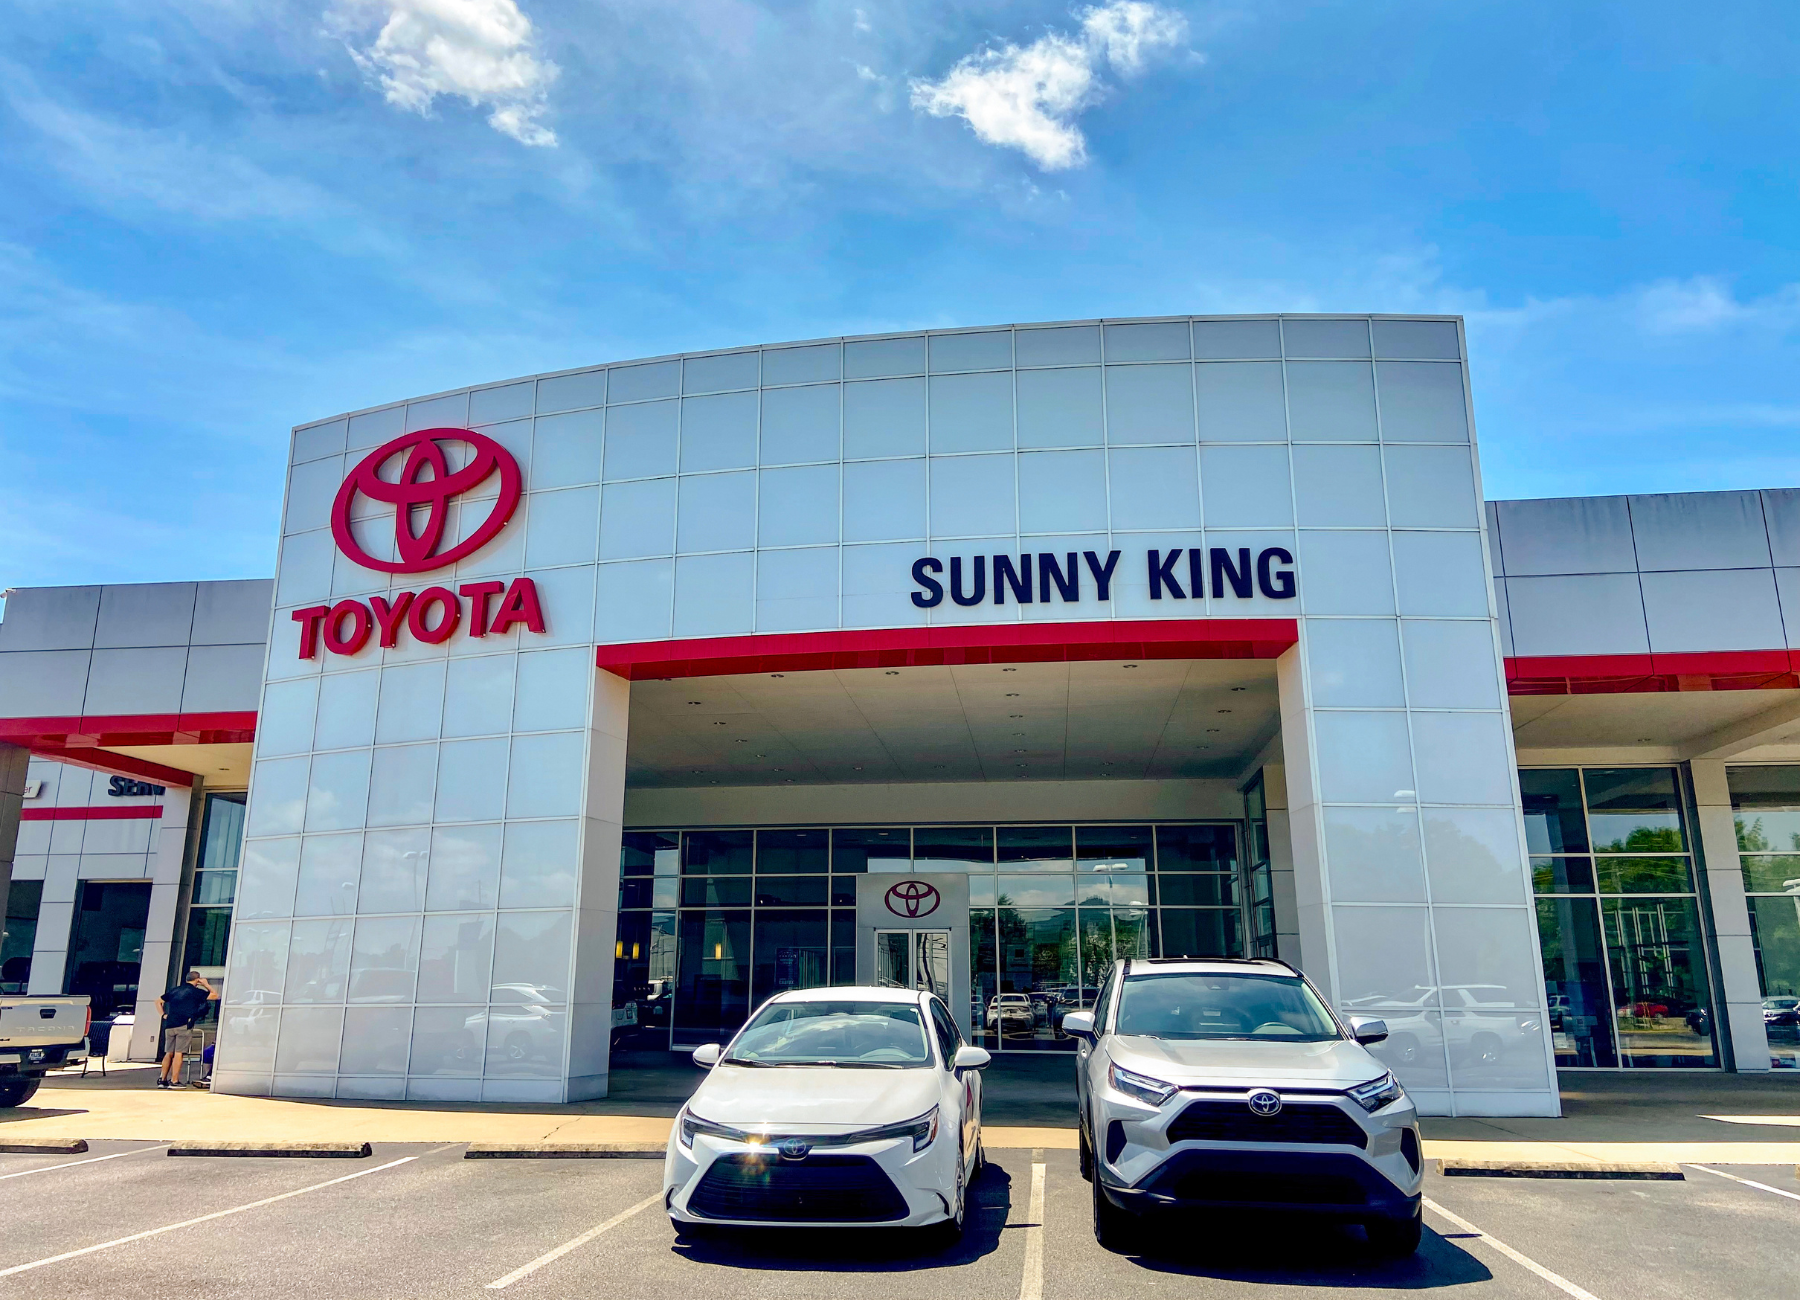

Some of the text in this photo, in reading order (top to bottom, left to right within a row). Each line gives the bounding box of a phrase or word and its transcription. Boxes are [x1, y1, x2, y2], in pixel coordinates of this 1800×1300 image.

[910, 547, 1297, 609] SUNNY KING
[291, 577, 546, 660] TOYOTA
